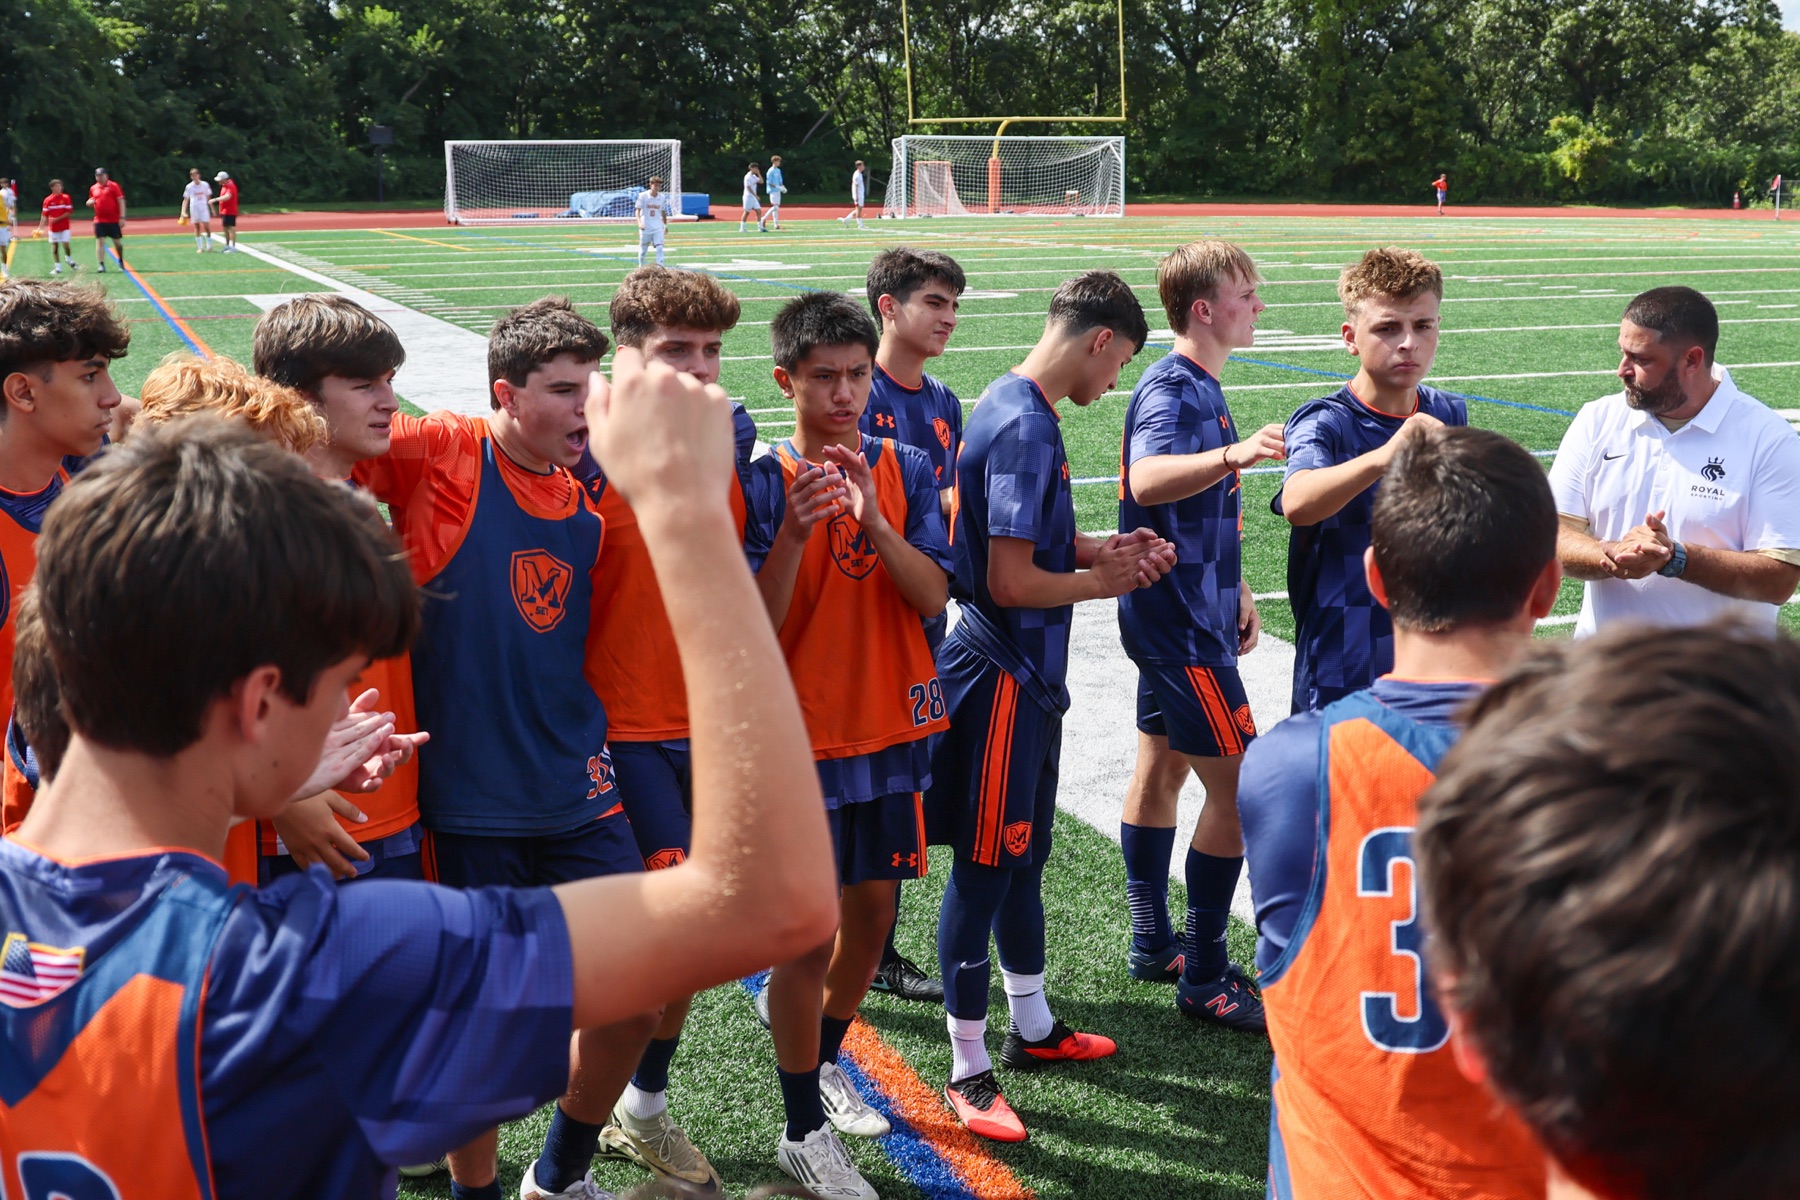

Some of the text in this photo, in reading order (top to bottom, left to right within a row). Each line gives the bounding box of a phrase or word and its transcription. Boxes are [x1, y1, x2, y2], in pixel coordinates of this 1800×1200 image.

[1691, 485, 1725, 496] ROYAL
[834, 521, 876, 560] M
[521, 560, 561, 609] M
[535, 606, 549, 616] SET
[909, 677, 945, 727] 28
